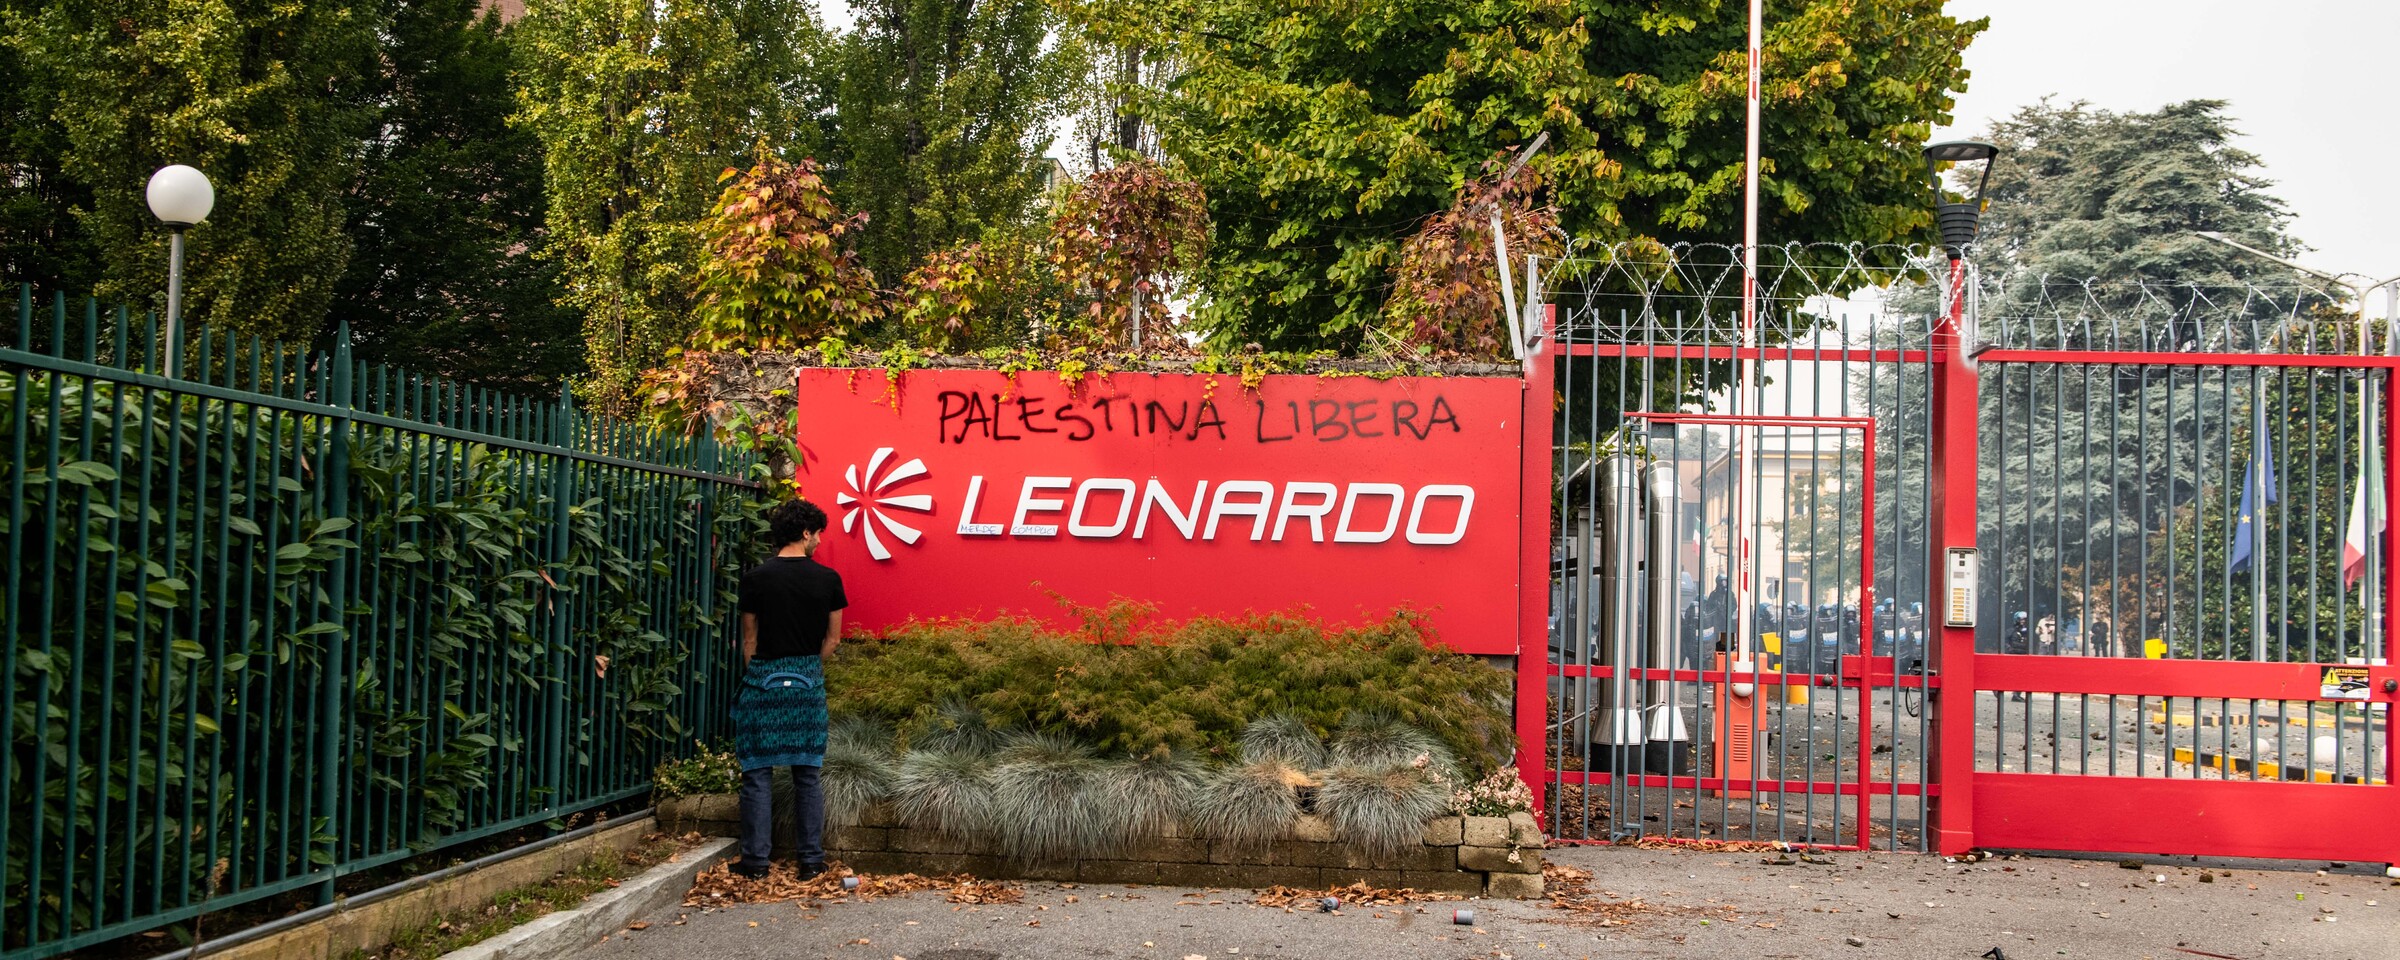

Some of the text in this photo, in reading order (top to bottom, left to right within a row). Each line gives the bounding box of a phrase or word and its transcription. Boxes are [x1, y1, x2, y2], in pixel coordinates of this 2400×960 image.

[938, 390, 1460, 443] PALESTINA LIBERA
[957, 476, 1474, 544] LEONARDO
